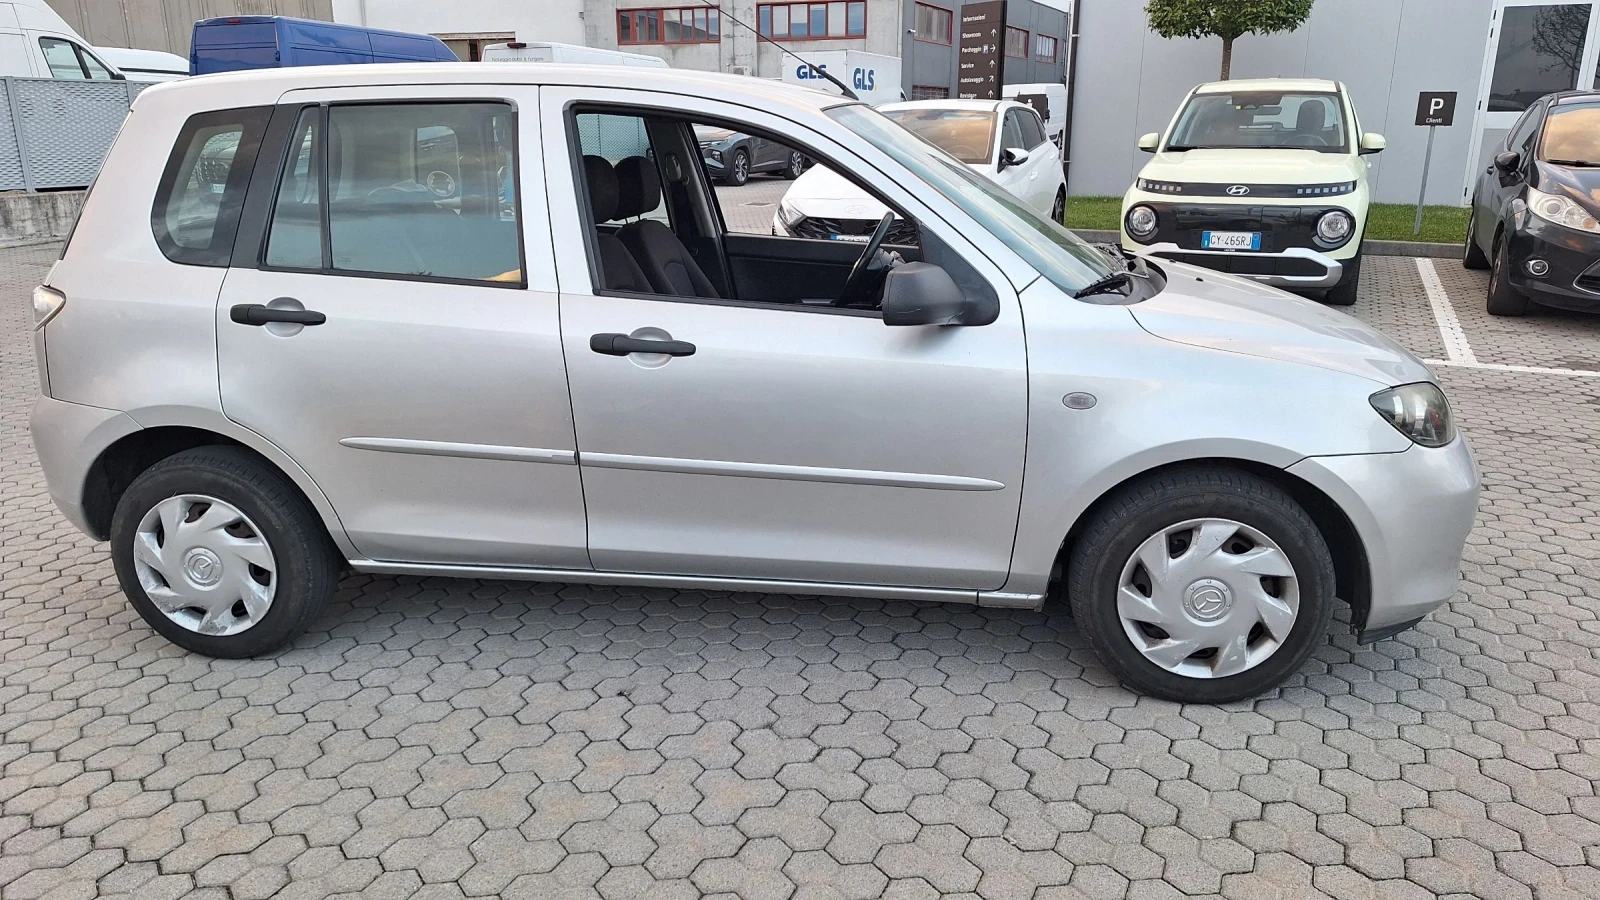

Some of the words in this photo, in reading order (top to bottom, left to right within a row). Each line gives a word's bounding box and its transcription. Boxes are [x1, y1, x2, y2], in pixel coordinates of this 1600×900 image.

[963, 14, 986, 22] Informazioni
[961, 46, 982, 54] Parcheggio
[796, 64, 827, 79] GLS
[853, 67, 875, 91] GLS
[1429, 98, 1444, 115] P
